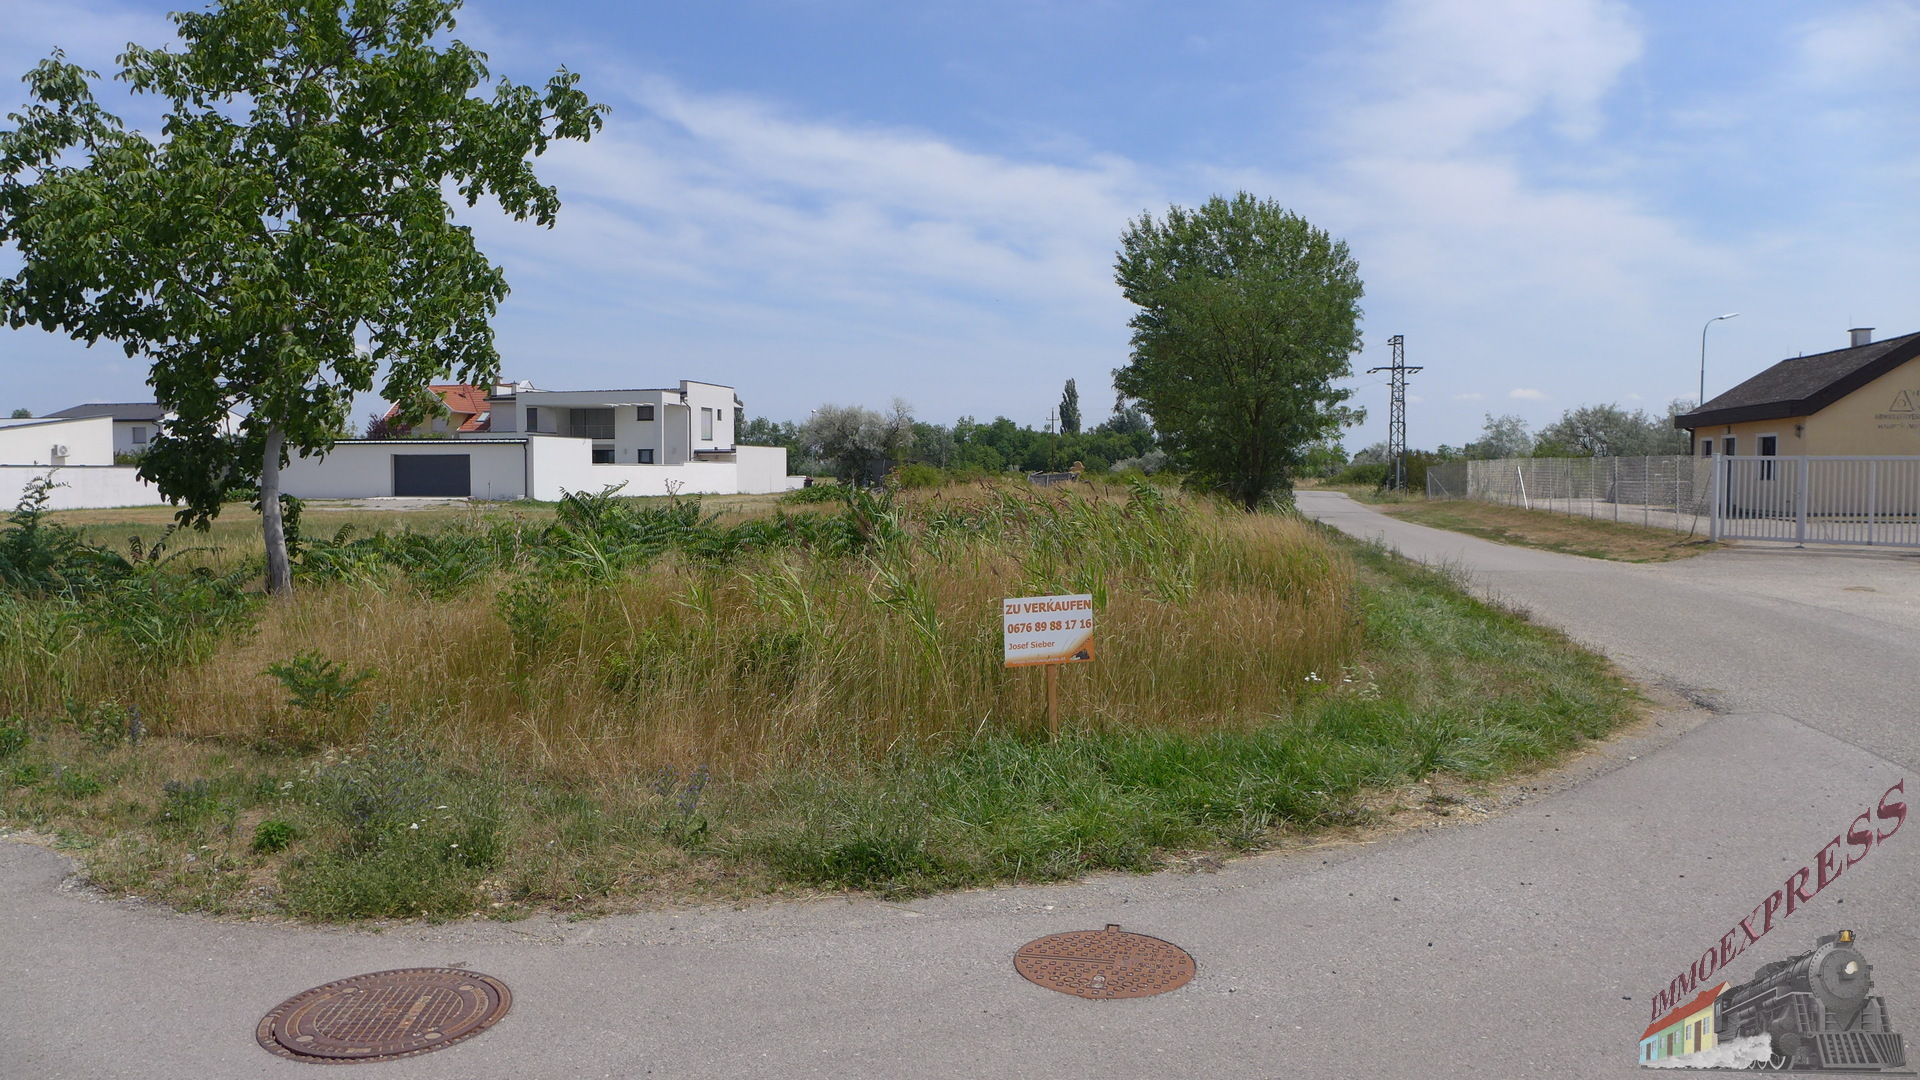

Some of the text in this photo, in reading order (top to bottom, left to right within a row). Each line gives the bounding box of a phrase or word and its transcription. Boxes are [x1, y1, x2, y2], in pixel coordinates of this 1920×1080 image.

[1005, 600, 1091, 615] ZU VERKAUFEN
[1008, 618, 1092, 634] 0676 89 88 17 16
[1008, 641, 1055, 651] Josef Sieber
